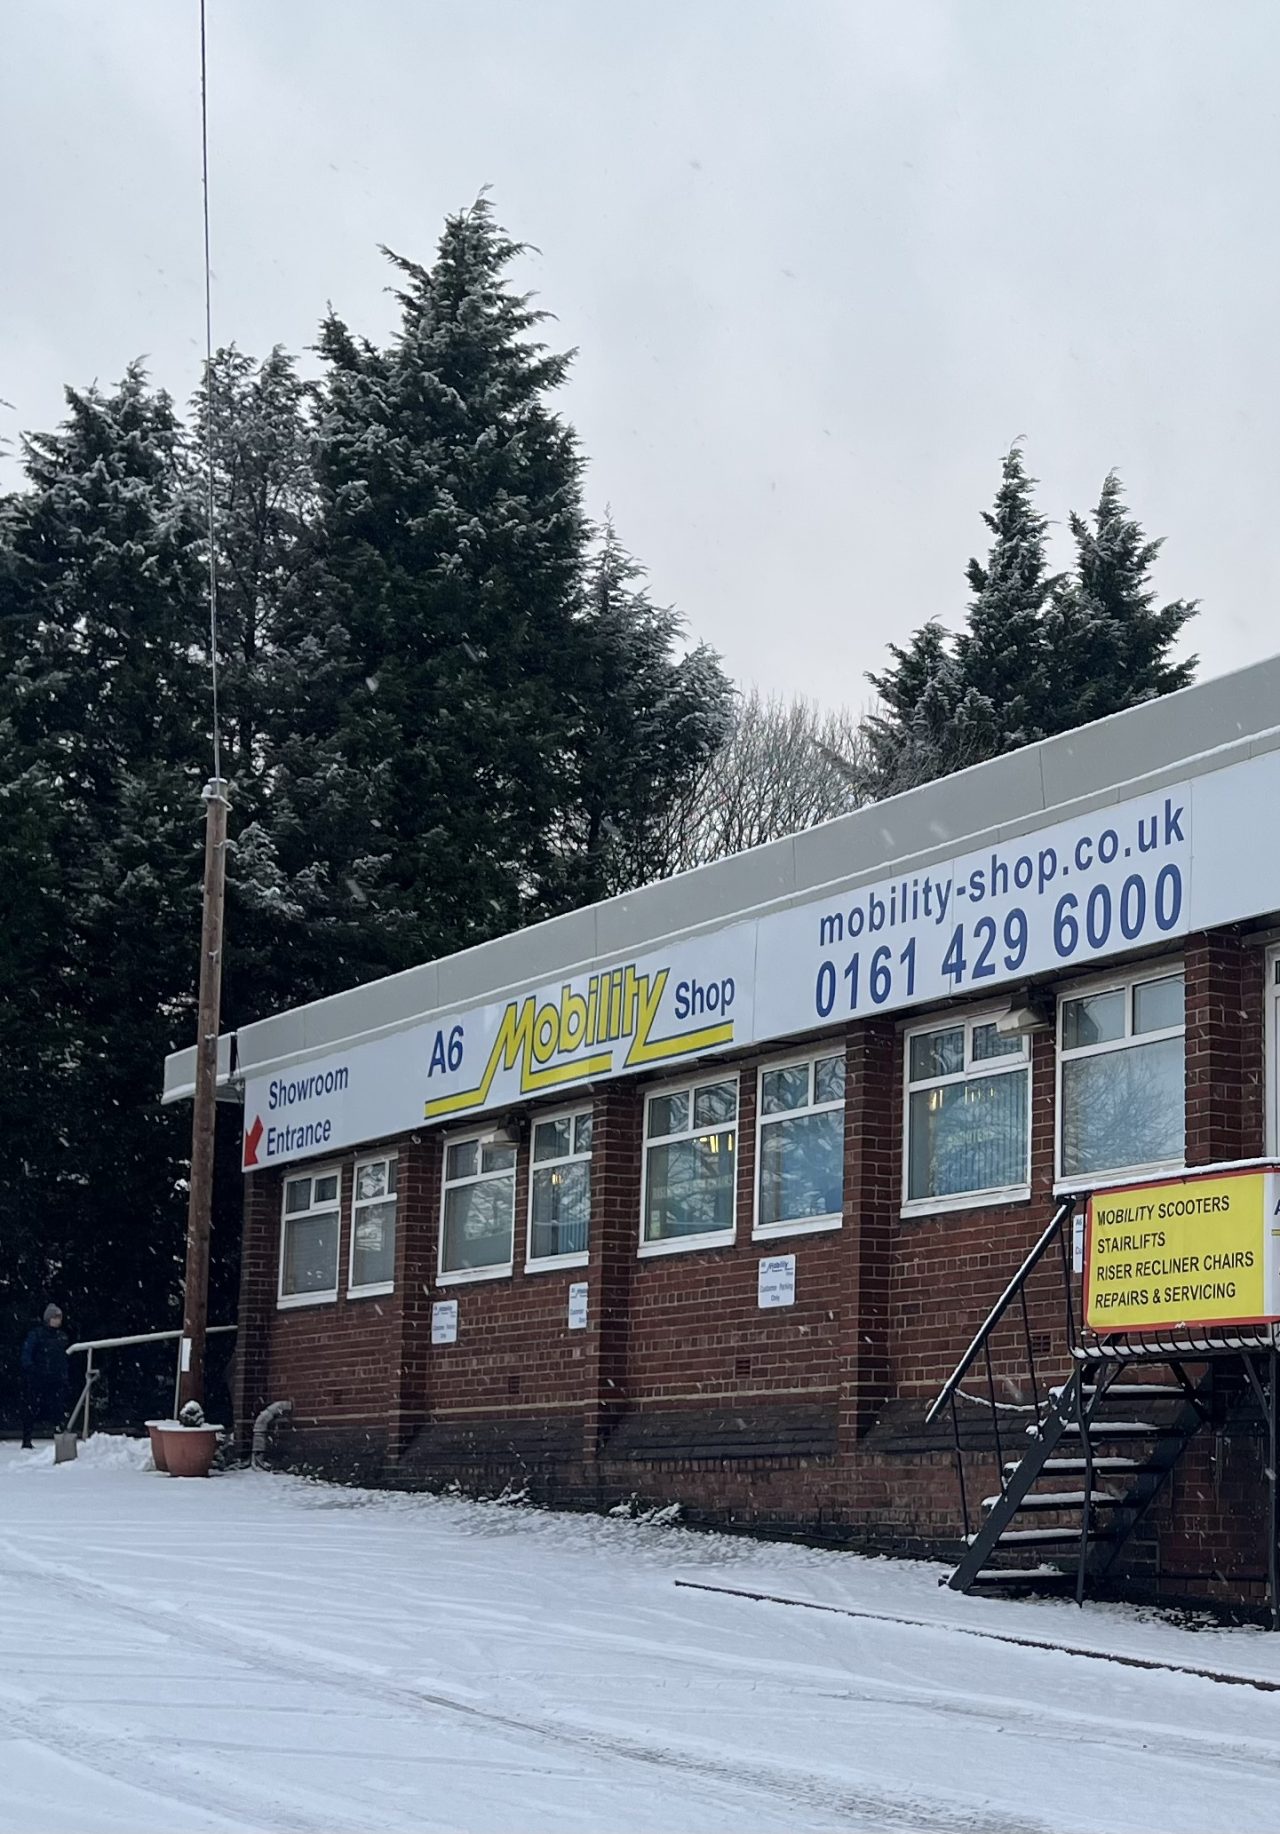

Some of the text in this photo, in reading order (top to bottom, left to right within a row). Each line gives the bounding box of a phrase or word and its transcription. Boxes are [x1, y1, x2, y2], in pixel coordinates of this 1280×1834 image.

[819, 798, 1185, 946] mobility-shop.co.uk
[815, 862, 1182, 1018] 0161 429 6000
[427, 963, 735, 1105] A6 Mobility Shop
[268, 1063, 349, 1110] Showroom
[266, 1115, 331, 1156] Entrance
[1097, 1195, 1230, 1226] MOBILITY SCOOTERS
[1097, 1231, 1166, 1254] STAIRLIFTS
[1097, 1251, 1255, 1281] RISER RECLINER CHAIRS
[1095, 1282, 1236, 1309] REPAIRS & SERVICING
